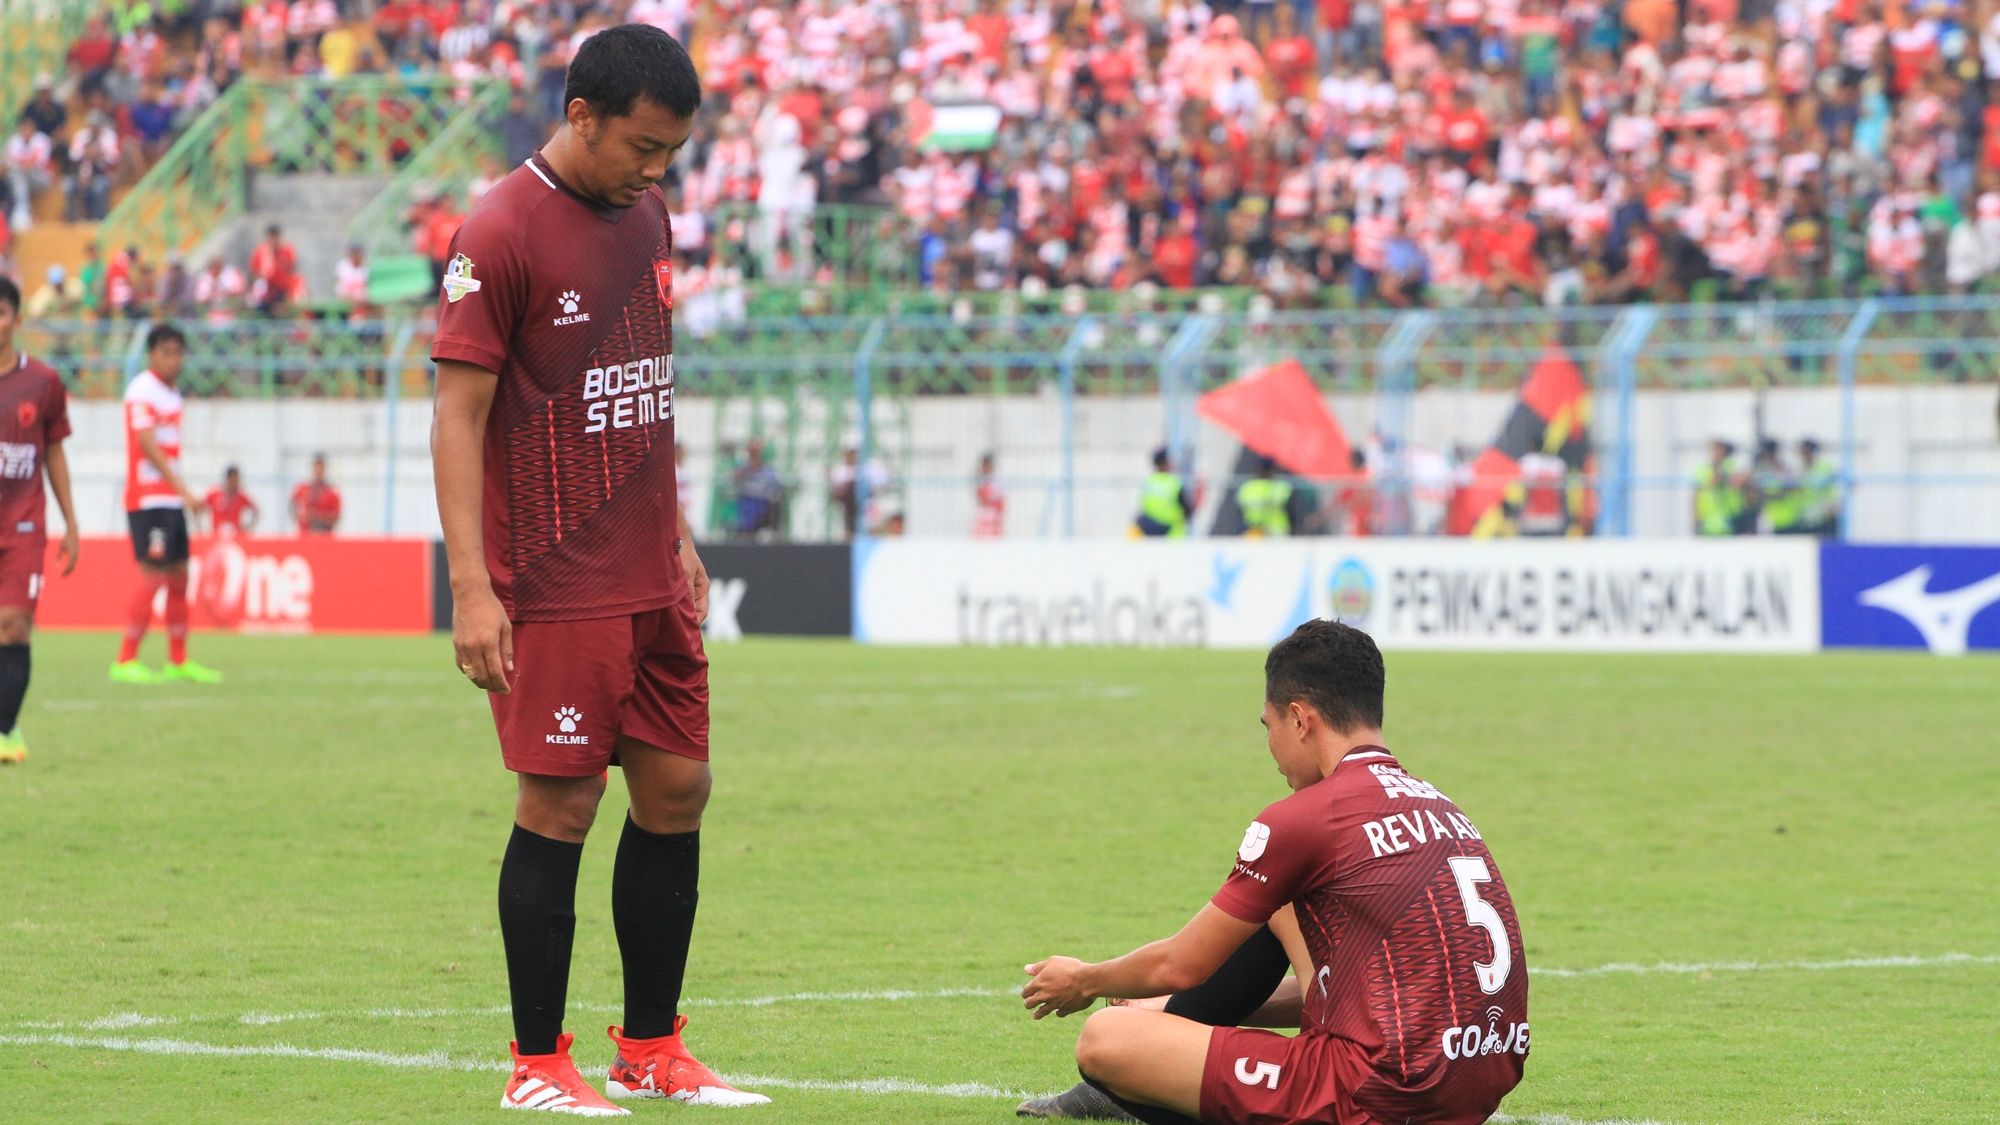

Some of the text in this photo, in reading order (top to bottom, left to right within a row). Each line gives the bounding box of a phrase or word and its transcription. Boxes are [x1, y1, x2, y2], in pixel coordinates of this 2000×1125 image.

[553, 313, 591, 327] KELME
[582, 354, 674, 401] BOSOW
[956, 574, 1209, 647] traveloka
[1387, 566, 1794, 637] PEMKAB BANGKALAN
[545, 734, 589, 745] KELME
[1447, 856, 1512, 995] 5
[1233, 1056, 1282, 1091] 5
